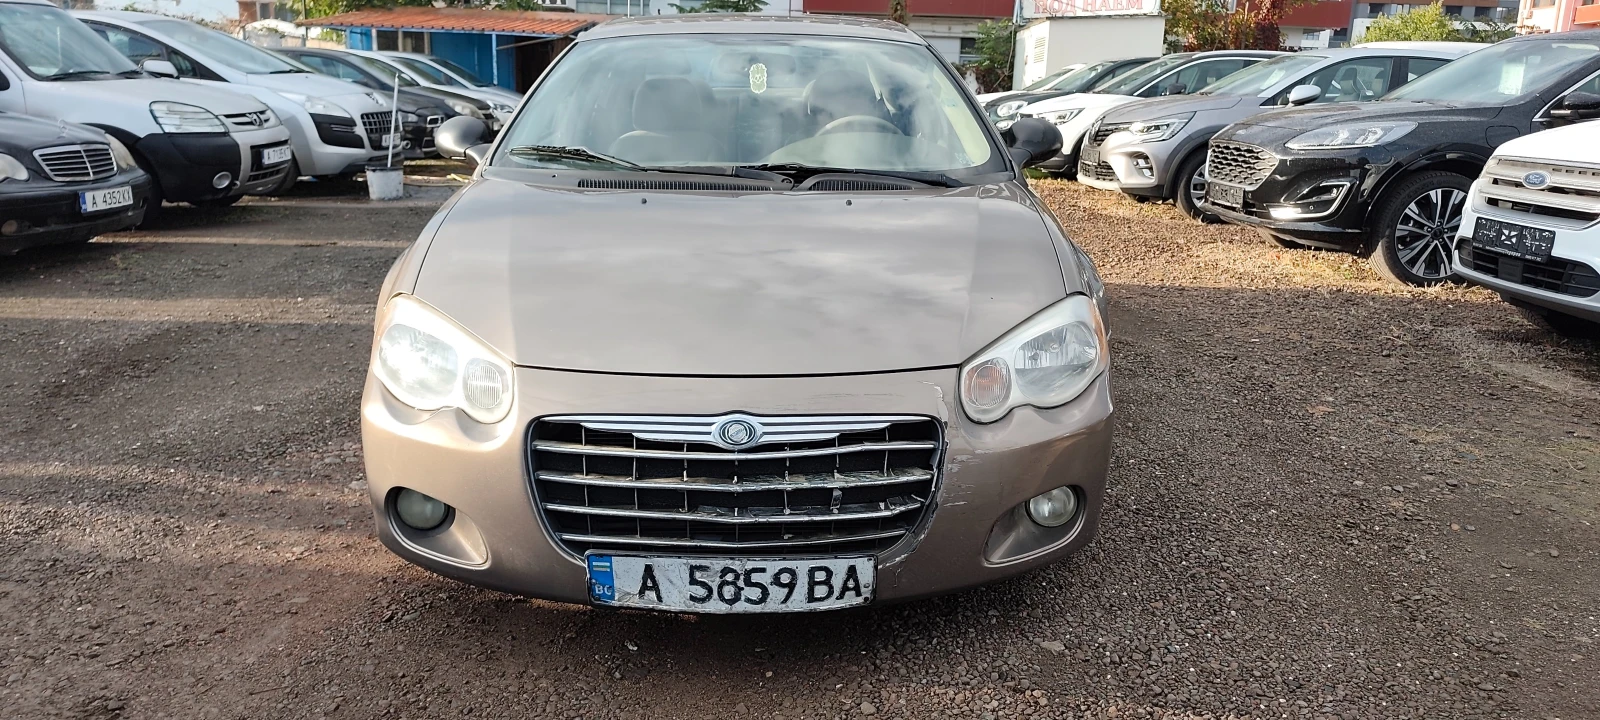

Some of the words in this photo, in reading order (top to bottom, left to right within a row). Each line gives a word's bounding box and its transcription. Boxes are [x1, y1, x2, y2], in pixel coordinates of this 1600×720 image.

[1082, 0, 1143, 12] НАЕМ
[92, 193, 98, 209] A
[637, 563, 664, 604] A
